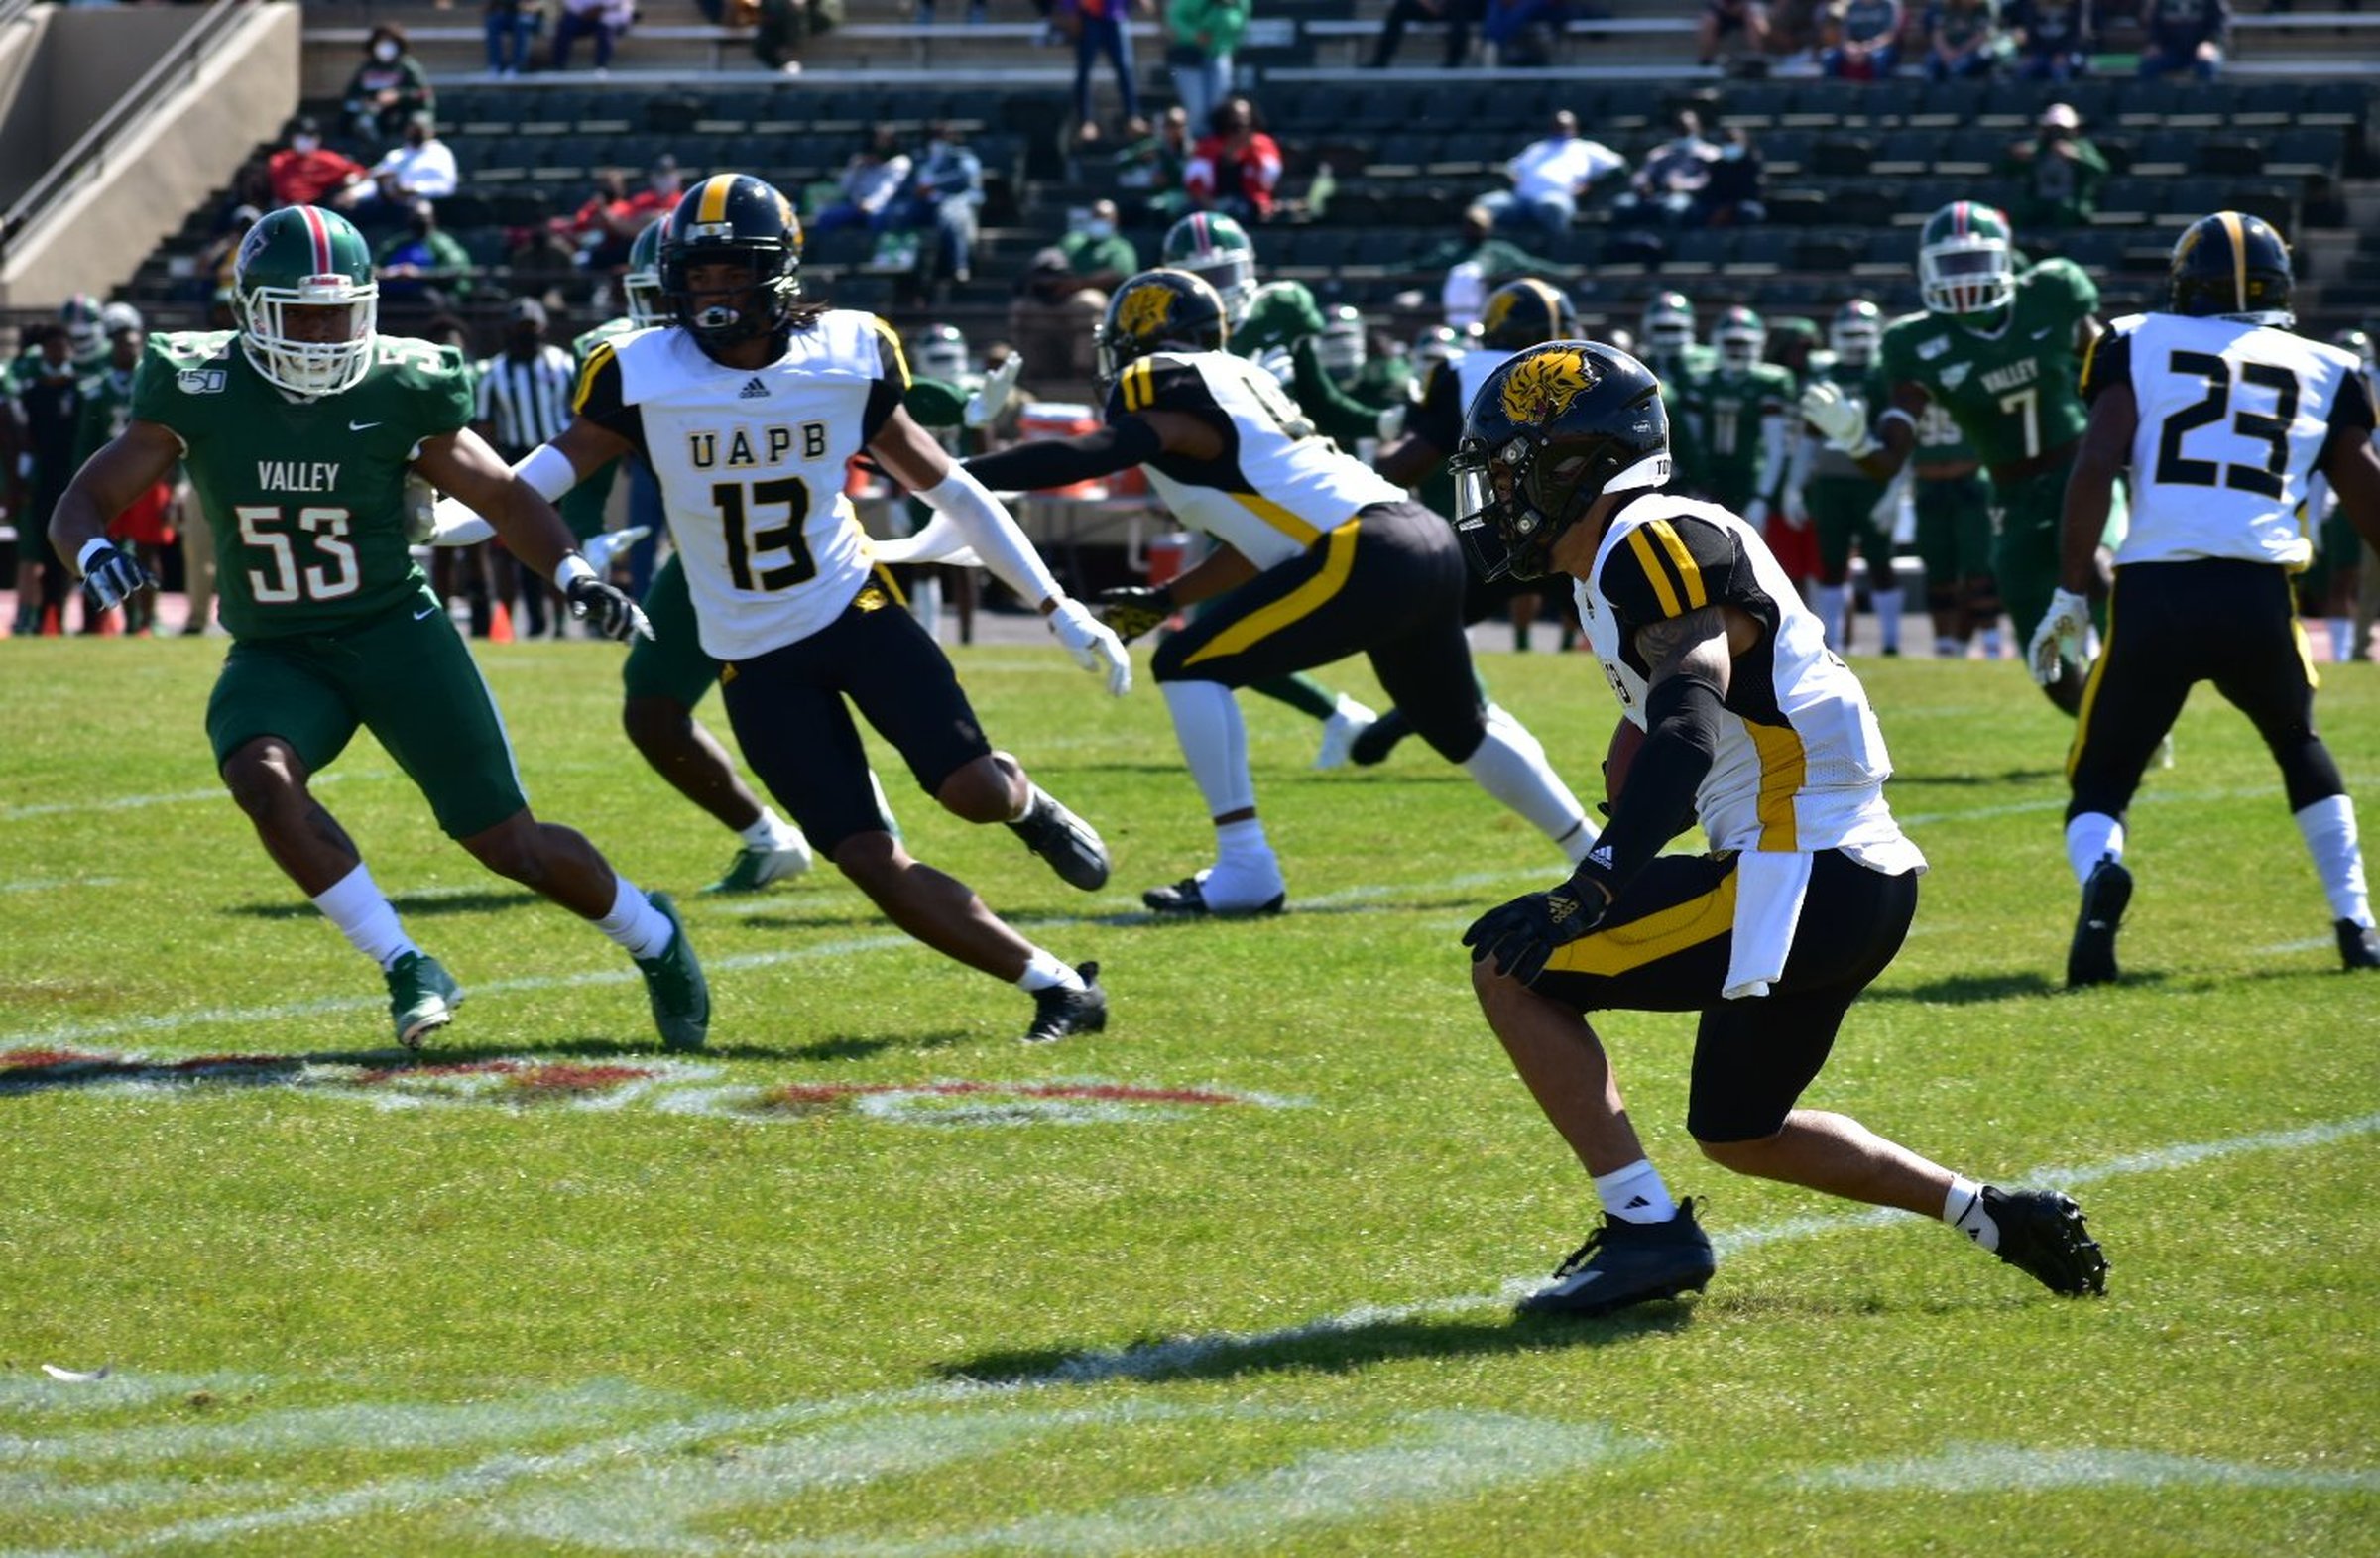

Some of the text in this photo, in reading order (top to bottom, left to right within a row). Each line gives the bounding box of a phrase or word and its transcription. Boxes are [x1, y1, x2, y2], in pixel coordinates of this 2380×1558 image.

[1979, 357, 2038, 394] VALLEY
[688, 419, 827, 470] UAPB
[1998, 388, 2040, 458] 7
[2155, 350, 2300, 502] 23
[257, 461, 339, 492] VALLEY
[234, 505, 359, 603] 53
[712, 476, 817, 592] 13
